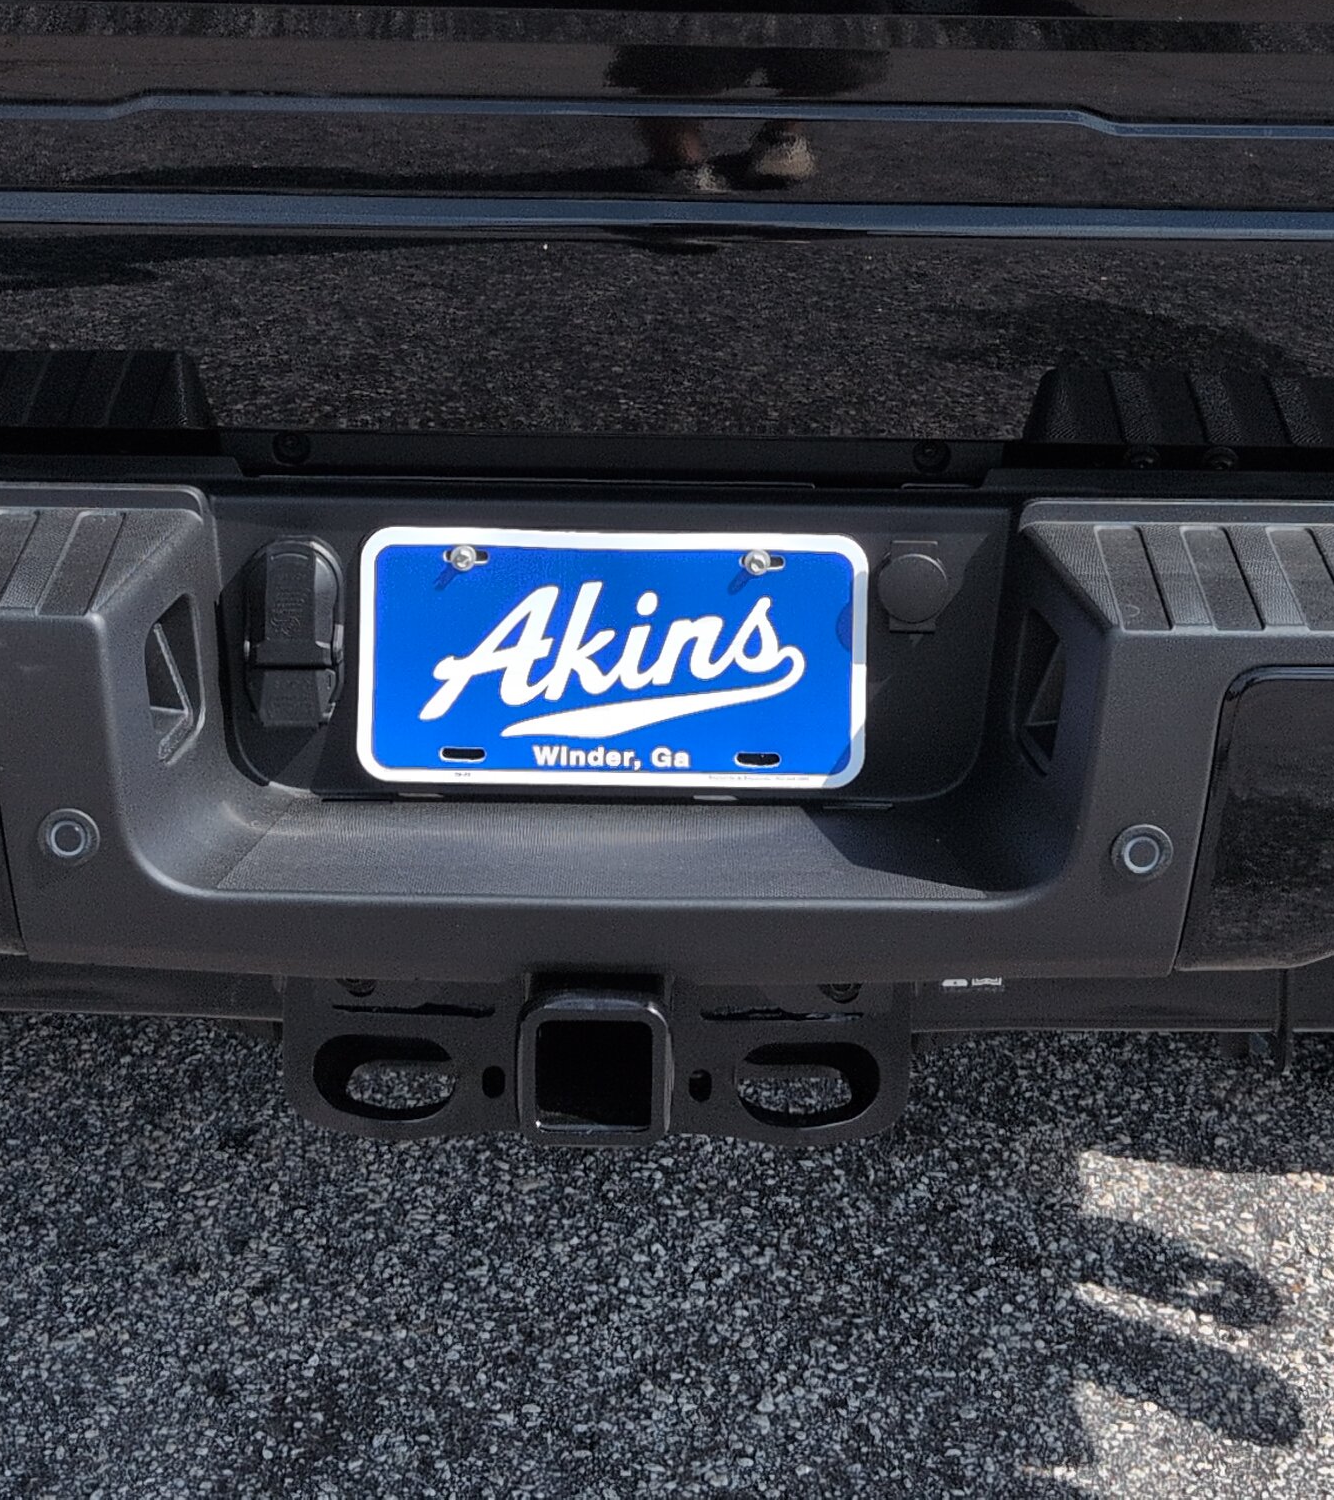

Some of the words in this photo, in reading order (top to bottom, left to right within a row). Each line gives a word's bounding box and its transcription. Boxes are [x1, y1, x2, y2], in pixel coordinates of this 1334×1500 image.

[419, 580, 806, 721] Akins
[532, 744, 642, 771] Winder,
[651, 746, 691, 769] Ga
